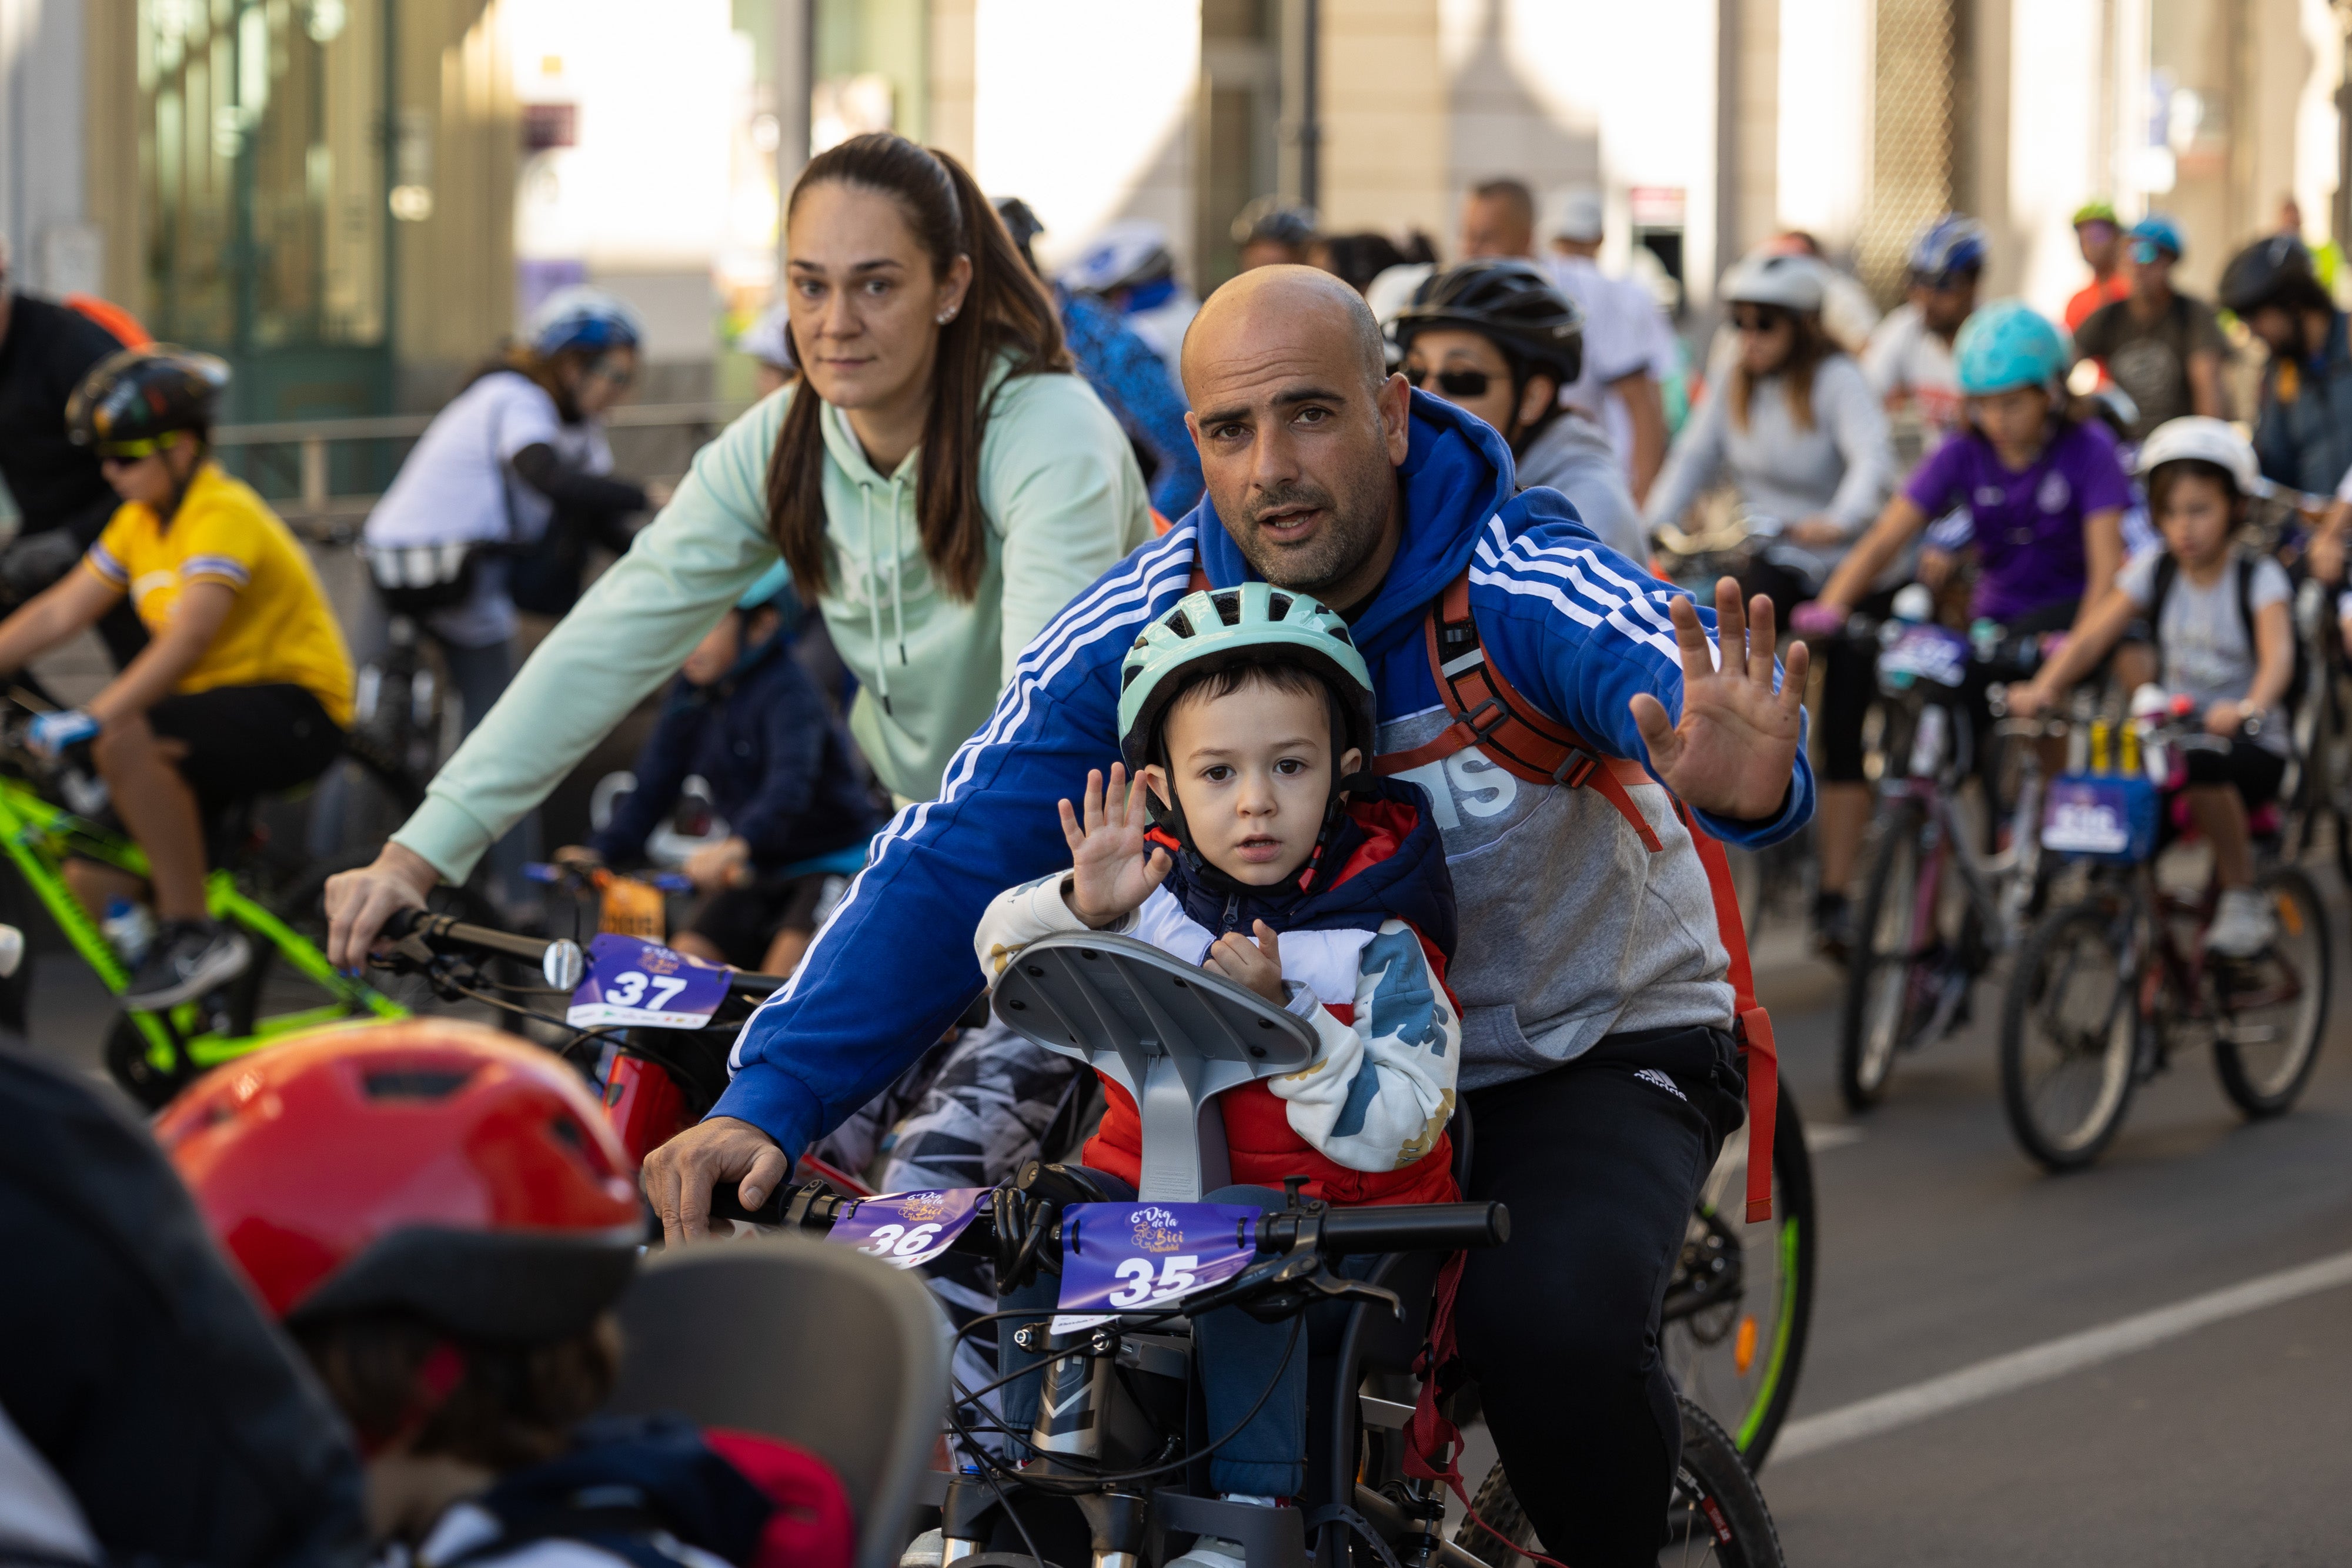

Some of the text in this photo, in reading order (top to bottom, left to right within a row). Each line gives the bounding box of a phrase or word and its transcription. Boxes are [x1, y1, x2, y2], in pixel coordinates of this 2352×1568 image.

[605, 971, 688, 1011] 37
[1633, 1072, 1687, 1102] adidas
[916, 1203, 944, 1216] Bici
[1151, 1215, 1179, 1228] de la
[857, 1223, 943, 1257] 36
[1154, 1228, 1184, 1246] Bici
[1109, 1255, 1198, 1307] 35
